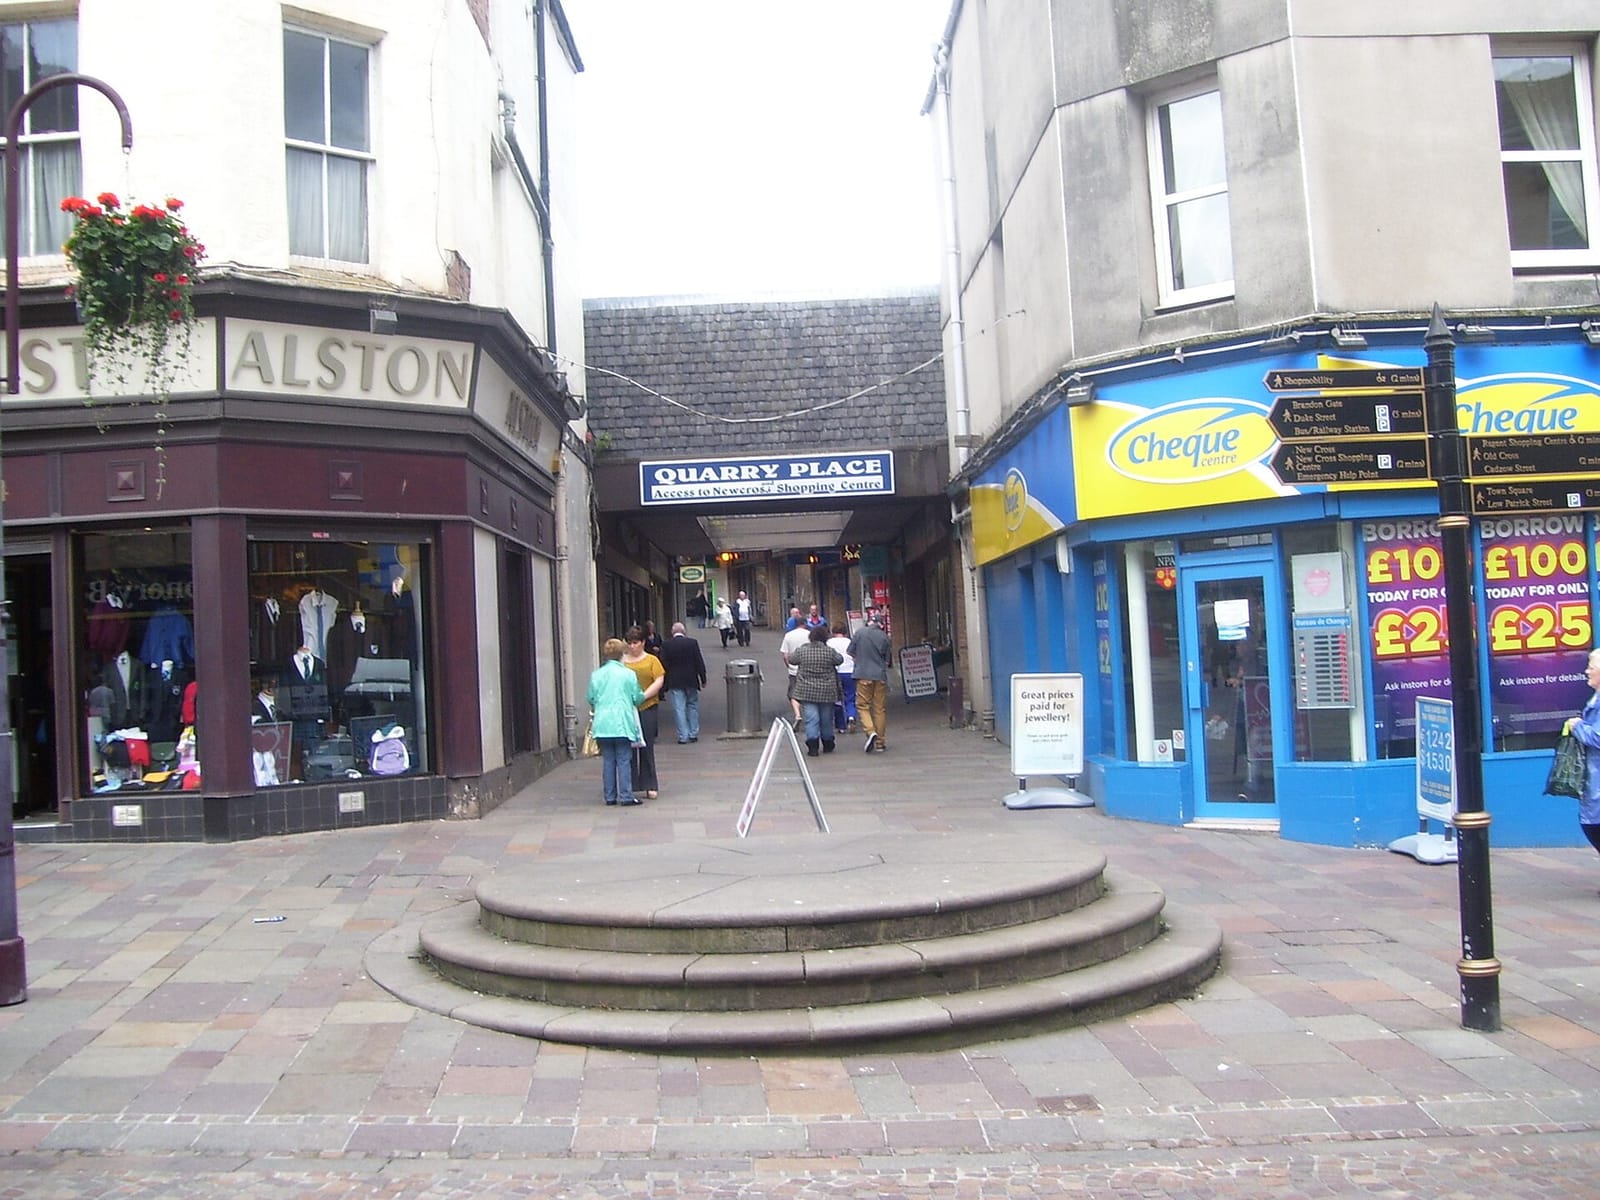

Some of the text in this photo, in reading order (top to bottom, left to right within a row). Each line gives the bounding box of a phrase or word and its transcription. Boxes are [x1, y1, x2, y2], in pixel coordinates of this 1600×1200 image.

[231, 330, 469, 399] ALSTON
[1283, 376, 1334, 385] Shopmobility
[1292, 399, 1343, 409] Brandon Gate
[1293, 413, 1336, 422] Duke Street
[1456, 402, 1578, 434] Cheque
[1294, 424, 1370, 435] Bus/Railway Station
[1128, 428, 1241, 468] Cheque
[1508, 438, 1542, 448] Shopping
[1543, 436, 1568, 445] Centre
[1295, 445, 1336, 454] New Cross
[1483, 451, 1520, 460] Old Cross
[1201, 453, 1237, 467] centre
[1295, 453, 1374, 463] New Cross Shopping
[654, 459, 882, 485] QUARRY PLACE
[1295, 463, 1321, 471] Centre
[1514, 464, 1536, 473] Street
[1297, 469, 1379, 481] Emergency Help Point
[653, 480, 881, 498] Access to Newcros Shopping Centre
[1486, 486, 1533, 496] Town Square
[1505, 498, 1530, 508] Patrick
[1532, 498, 1553, 507] Street
[1361, 519, 1442, 542] BORRO
[1480, 514, 1584, 540] BORROW
[1368, 546, 1442, 583] £10
[1485, 542, 1588, 580] £100
[1367, 589, 1410, 603] TODAY
[1412, 587, 1439, 600] FOR
[1486, 586, 1527, 599] TODAY
[1529, 585, 1555, 597] FOR
[1557, 582, 1589, 595] ONLY
[1375, 611, 1449, 655] £2
[1491, 605, 1592, 651] £25
[1384, 682, 1400, 691] Ask
[1400, 681, 1429, 689] instore
[1430, 679, 1442, 687] for
[1499, 678, 1515, 686] Ask
[1515, 676, 1544, 685] instore
[1545, 674, 1557, 683] for
[1021, 689, 1074, 701] Great prices
[1030, 701, 1066, 712] paid for
[1025, 713, 1070, 724] jewellery!
